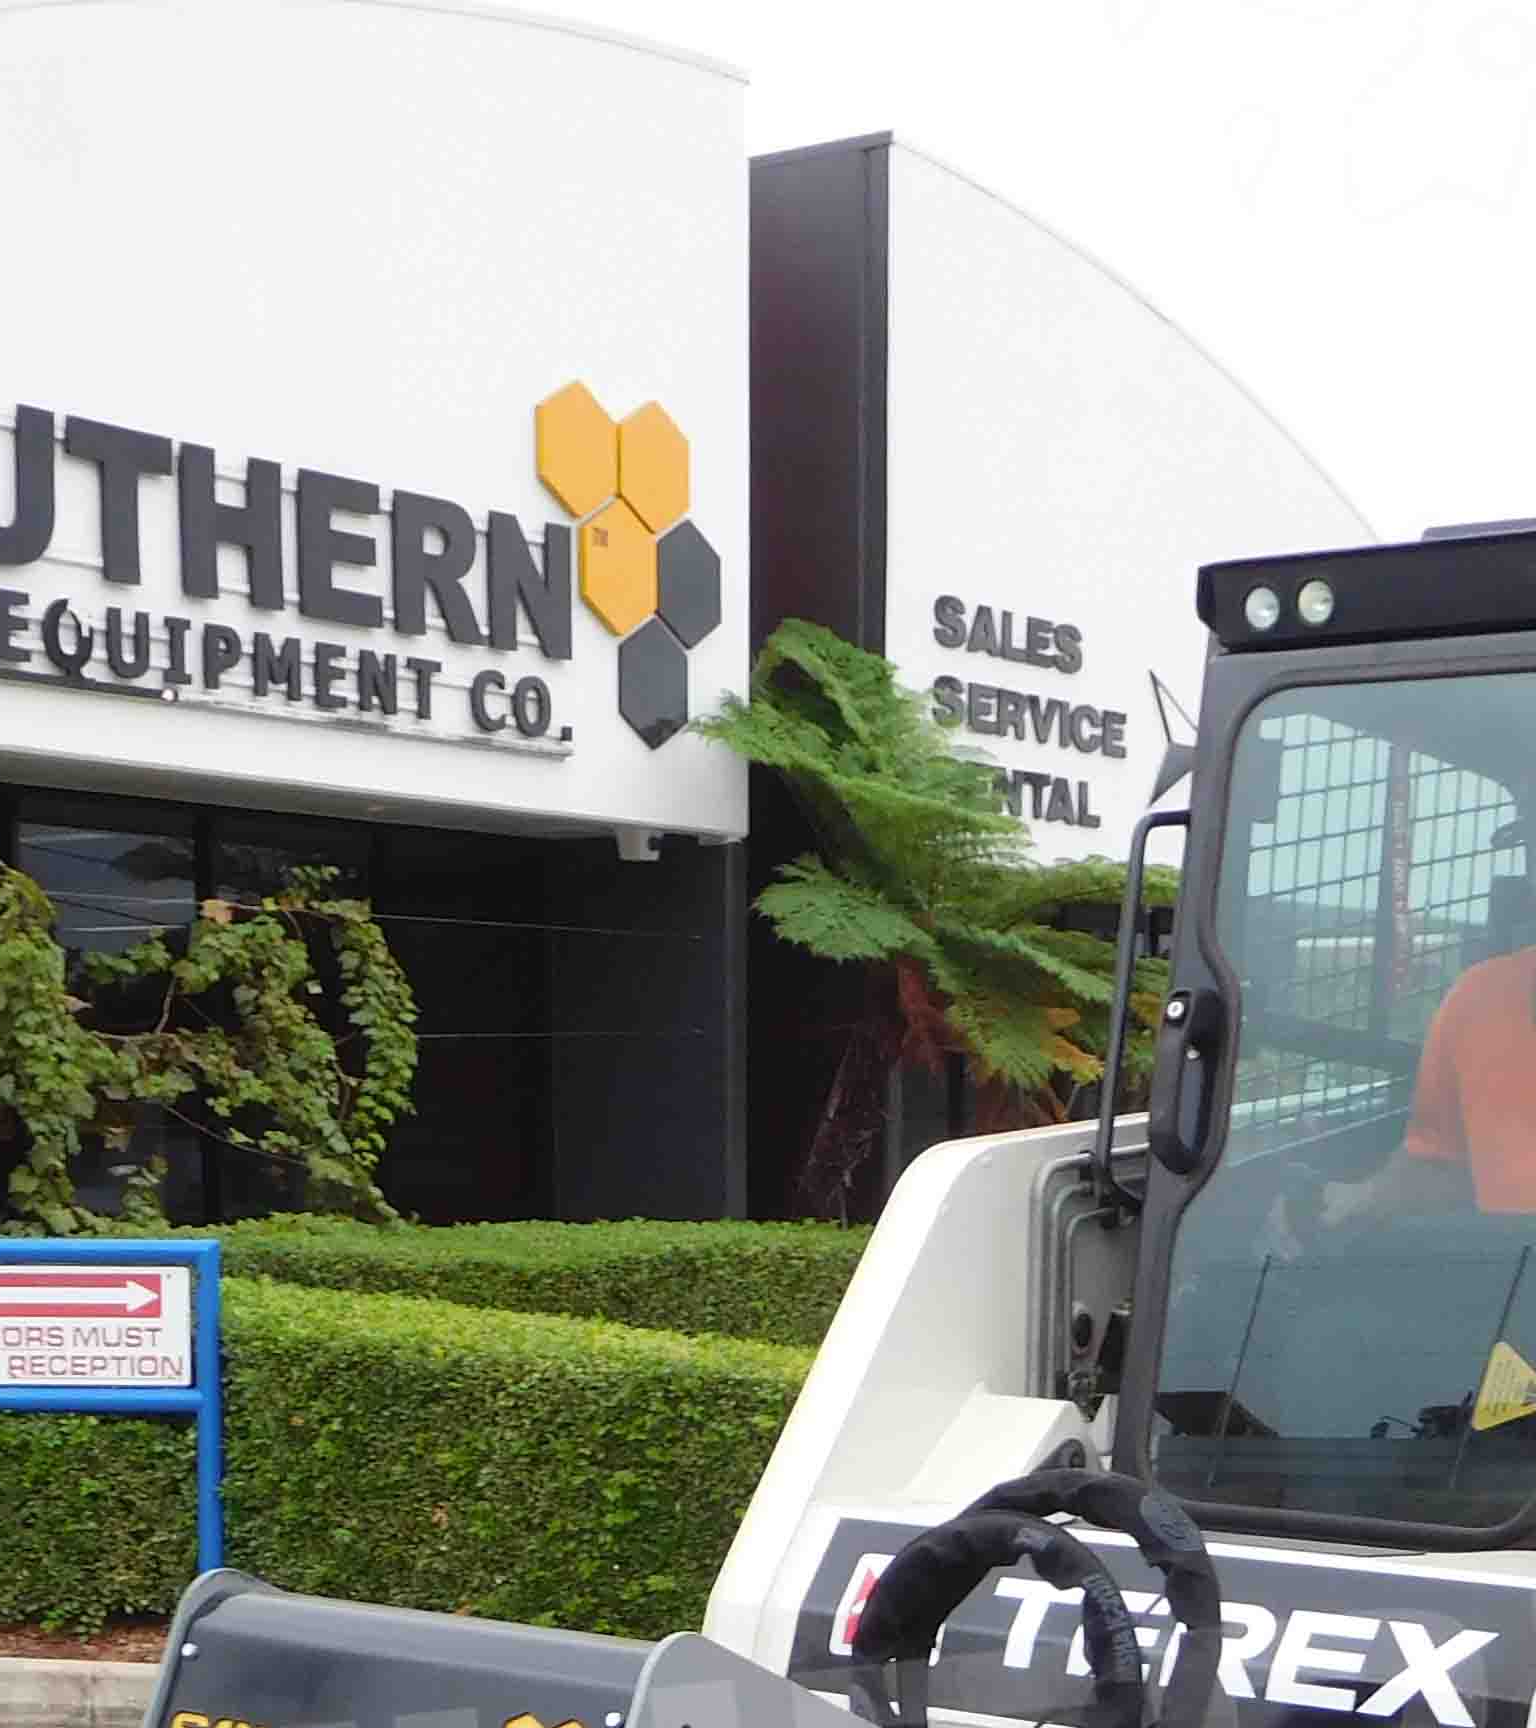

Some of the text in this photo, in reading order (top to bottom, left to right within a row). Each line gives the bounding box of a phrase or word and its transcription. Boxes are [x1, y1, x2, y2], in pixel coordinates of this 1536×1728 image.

[932, 594, 1082, 674] SALES
[470, 669, 573, 742] CO.
[931, 675, 1127, 758] SERVICE
[994, 768, 1101, 829] NTAL
[8, 1355, 184, 1377] RECEPTION
[72, 1327, 162, 1347] MUST
